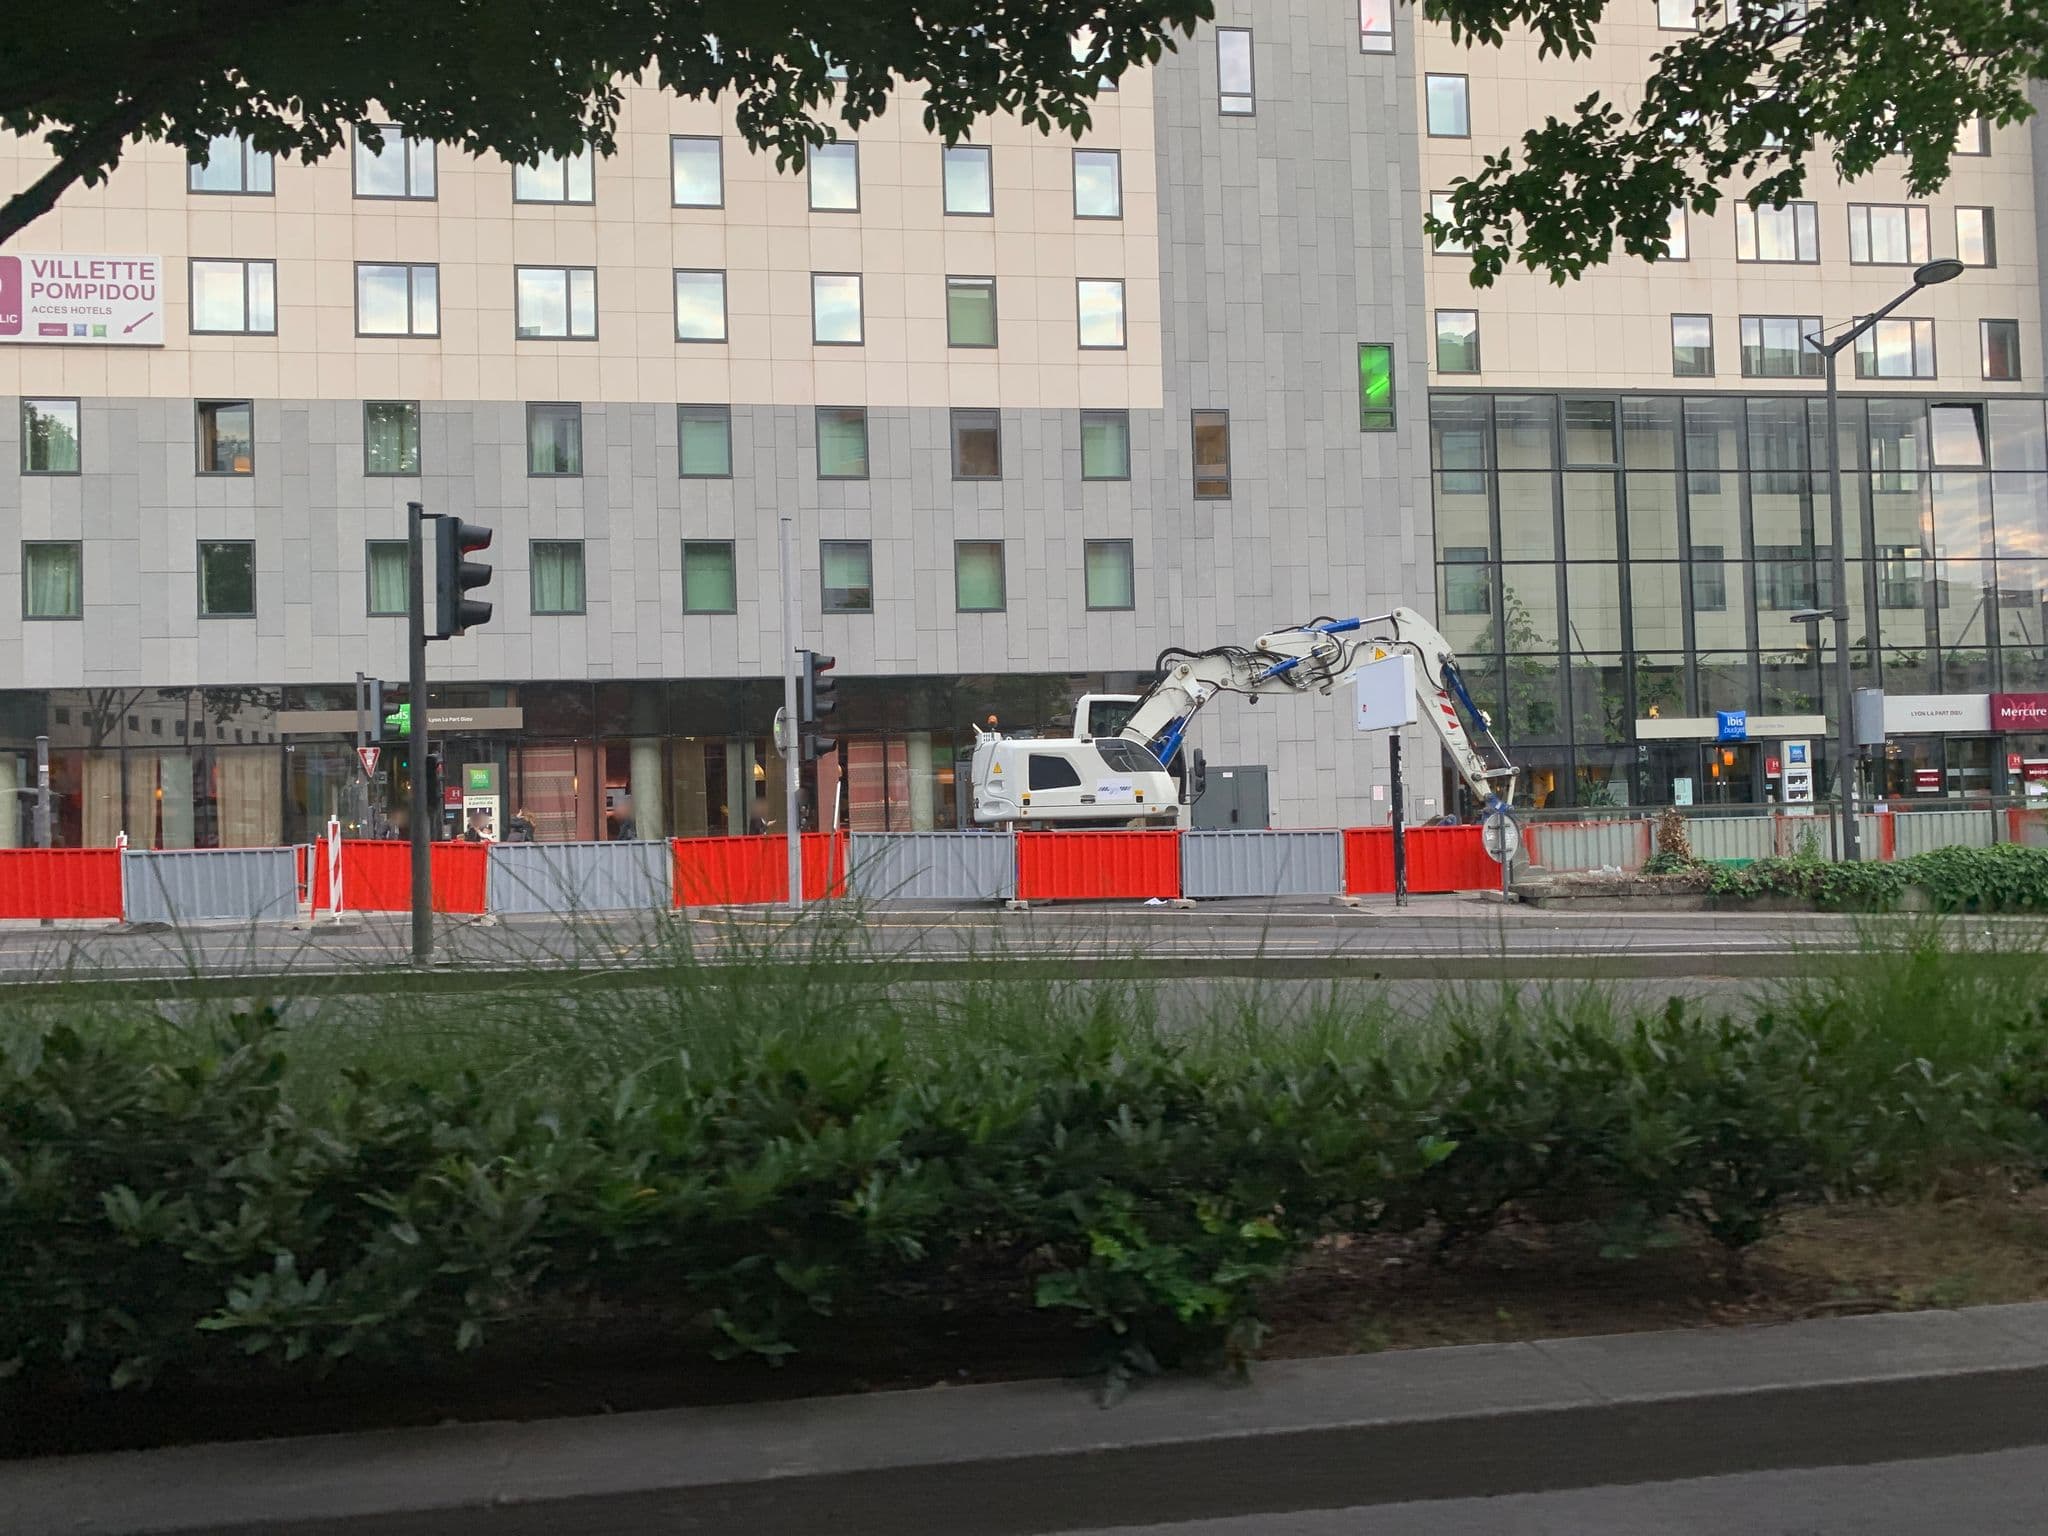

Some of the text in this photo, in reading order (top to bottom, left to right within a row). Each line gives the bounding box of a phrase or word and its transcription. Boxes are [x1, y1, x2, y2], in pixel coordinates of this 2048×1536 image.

[31, 259, 155, 280] VILLETTE
[31, 282, 155, 301] POMPIDOU
[31, 305, 112, 315] ACCES HOTELS
[2001, 707, 2048, 717] Mercure
[1727, 716, 1743, 726] ibis
[1724, 726, 1745, 736] budget
